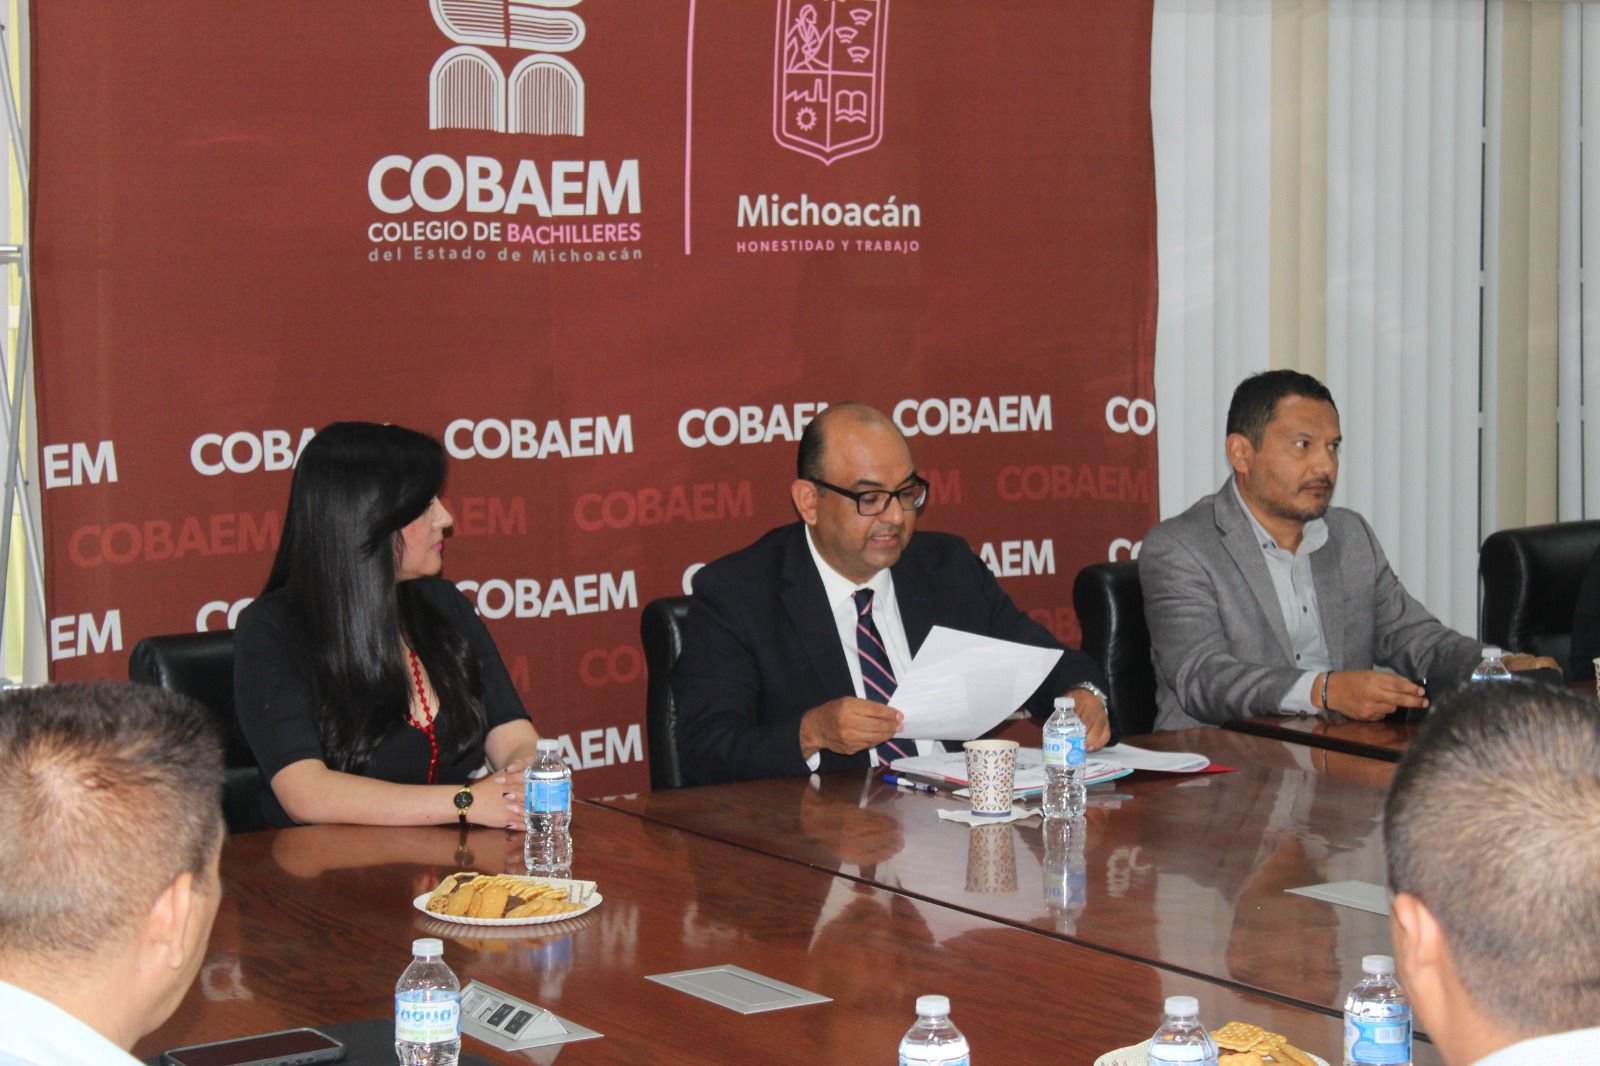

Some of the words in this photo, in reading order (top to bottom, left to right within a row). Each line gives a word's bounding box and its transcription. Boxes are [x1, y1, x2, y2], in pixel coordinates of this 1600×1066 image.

[367, 153, 641, 217] COBAEM
[737, 194, 921, 227] Michoacán
[368, 221, 468, 242] COLEGIO
[473, 222, 502, 241] DE
[507, 223, 641, 245] BACHILLERES
[368, 246, 402, 262] del
[413, 245, 487, 261] Estado
[497, 247, 522, 262] de
[532, 246, 642, 264] Michoacán
[736, 239, 835, 253] HONESTIDAD
[841, 240, 849, 251] Y
[855, 240, 920, 254] TRABAJO
[444, 414, 634, 460] COBAEM
[678, 402, 829, 448] COBAE
[893, 395, 1053, 437] COBAEM
[1105, 396, 1157, 436] CO
[43, 440, 118, 489] EM
[997, 463, 1150, 504] COBAEM
[574, 481, 754, 531] COBAEM
[68, 510, 281, 568] COBAEM
[51, 609, 123, 661] EM
